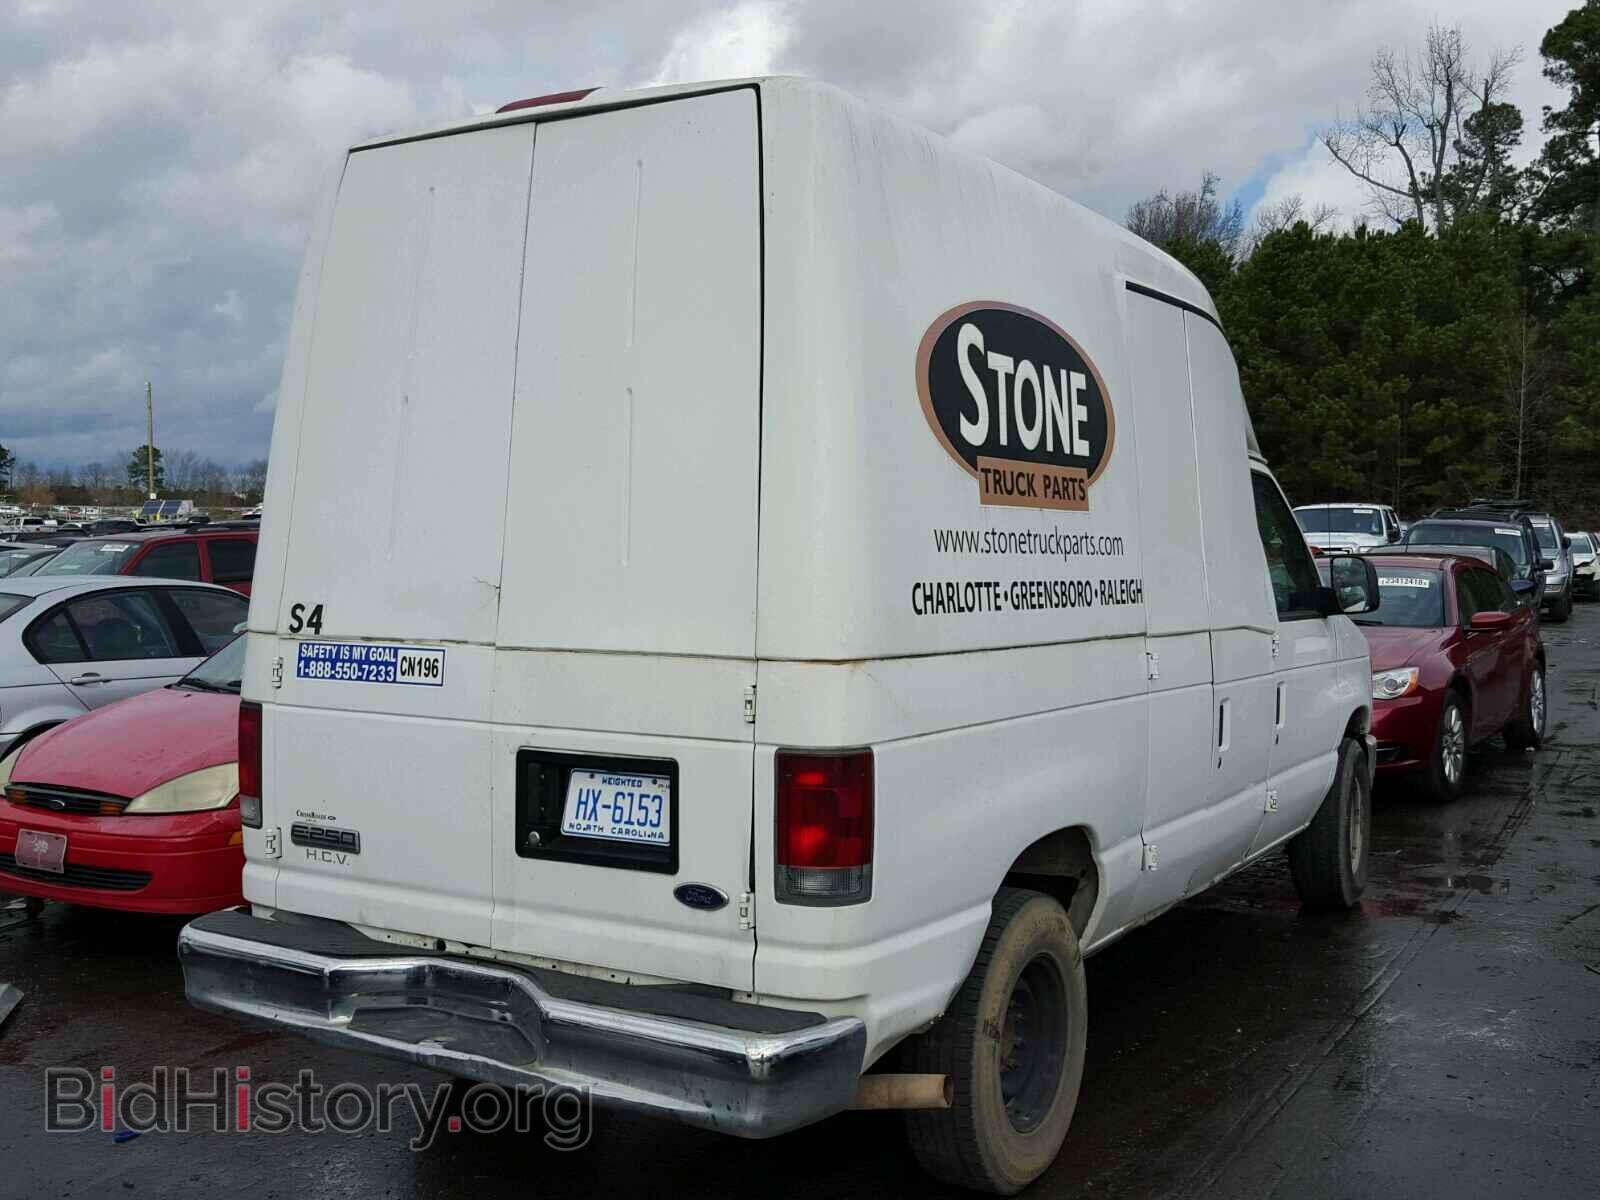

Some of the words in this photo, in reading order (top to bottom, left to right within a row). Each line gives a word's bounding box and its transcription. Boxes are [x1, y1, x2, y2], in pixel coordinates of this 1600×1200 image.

[957, 322, 1090, 457] STONE
[980, 468, 1037, 498] TRUCK
[1043, 475, 1087, 501] PARTS
[934, 525, 1124, 562] www.stonetruckparts.com
[912, 582, 1002, 615] CHARLOTTE
[1010, 580, 1093, 610] GREENSBORO
[1100, 579, 1144, 605] RALEIGH
[288, 602, 324, 635] S4
[300, 643, 338, 660] SAFETY
[339, 646, 350, 660] IS
[352, 647, 368, 661] MY
[369, 649, 396, 663] GOAL
[400, 655, 440, 679] CN196
[298, 659, 395, 682] 1-888-550-7233
[601, 775, 643, 789] WEIGHTED
[575, 787, 664, 829] HX-6153
[610, 826, 665, 840] CAROLINA
